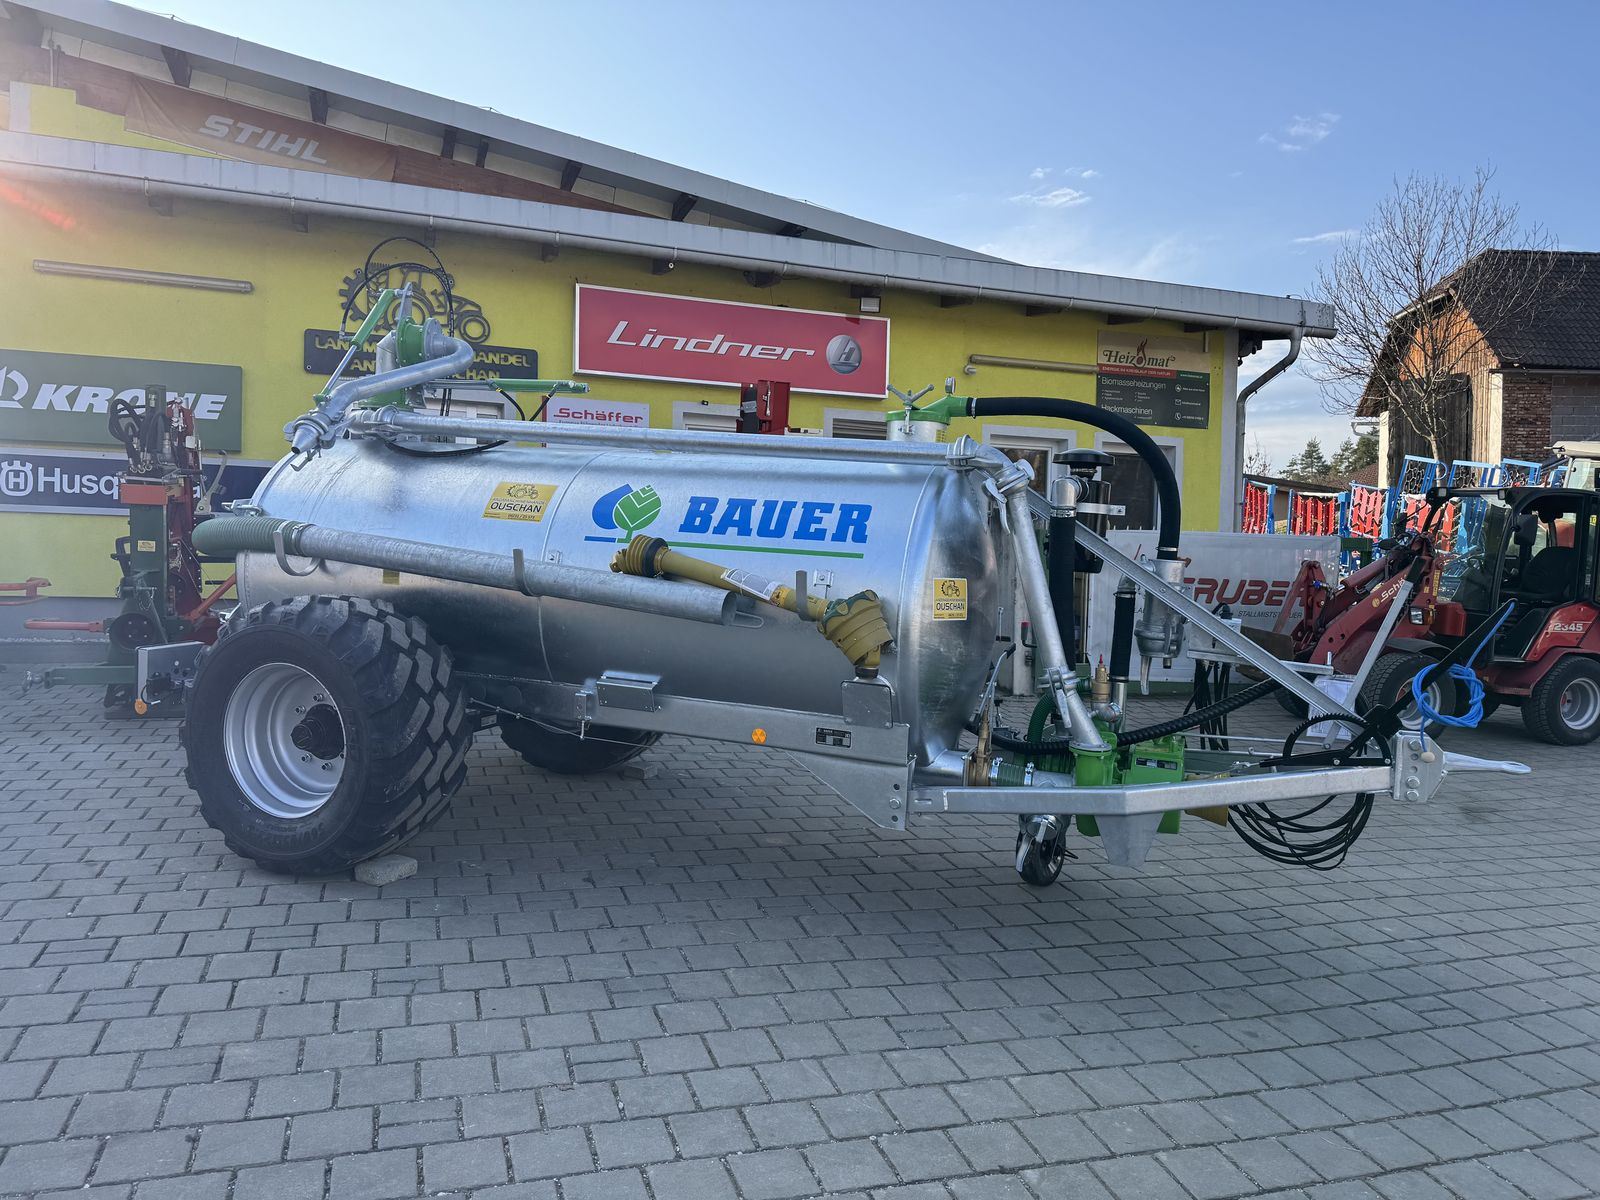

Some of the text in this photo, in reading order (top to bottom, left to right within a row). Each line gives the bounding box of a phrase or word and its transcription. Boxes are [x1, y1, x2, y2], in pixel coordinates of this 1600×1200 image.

[200, 114, 327, 165] STIHL
[606, 320, 816, 360] Lindner
[1101, 377, 1167, 390] Biomasseheizungen
[553, 407, 643, 424] Schäffer
[490, 501, 542, 513] OUSCHAN
[678, 496, 873, 544] BAUER
[936, 602, 965, 611] OUSCHAN
